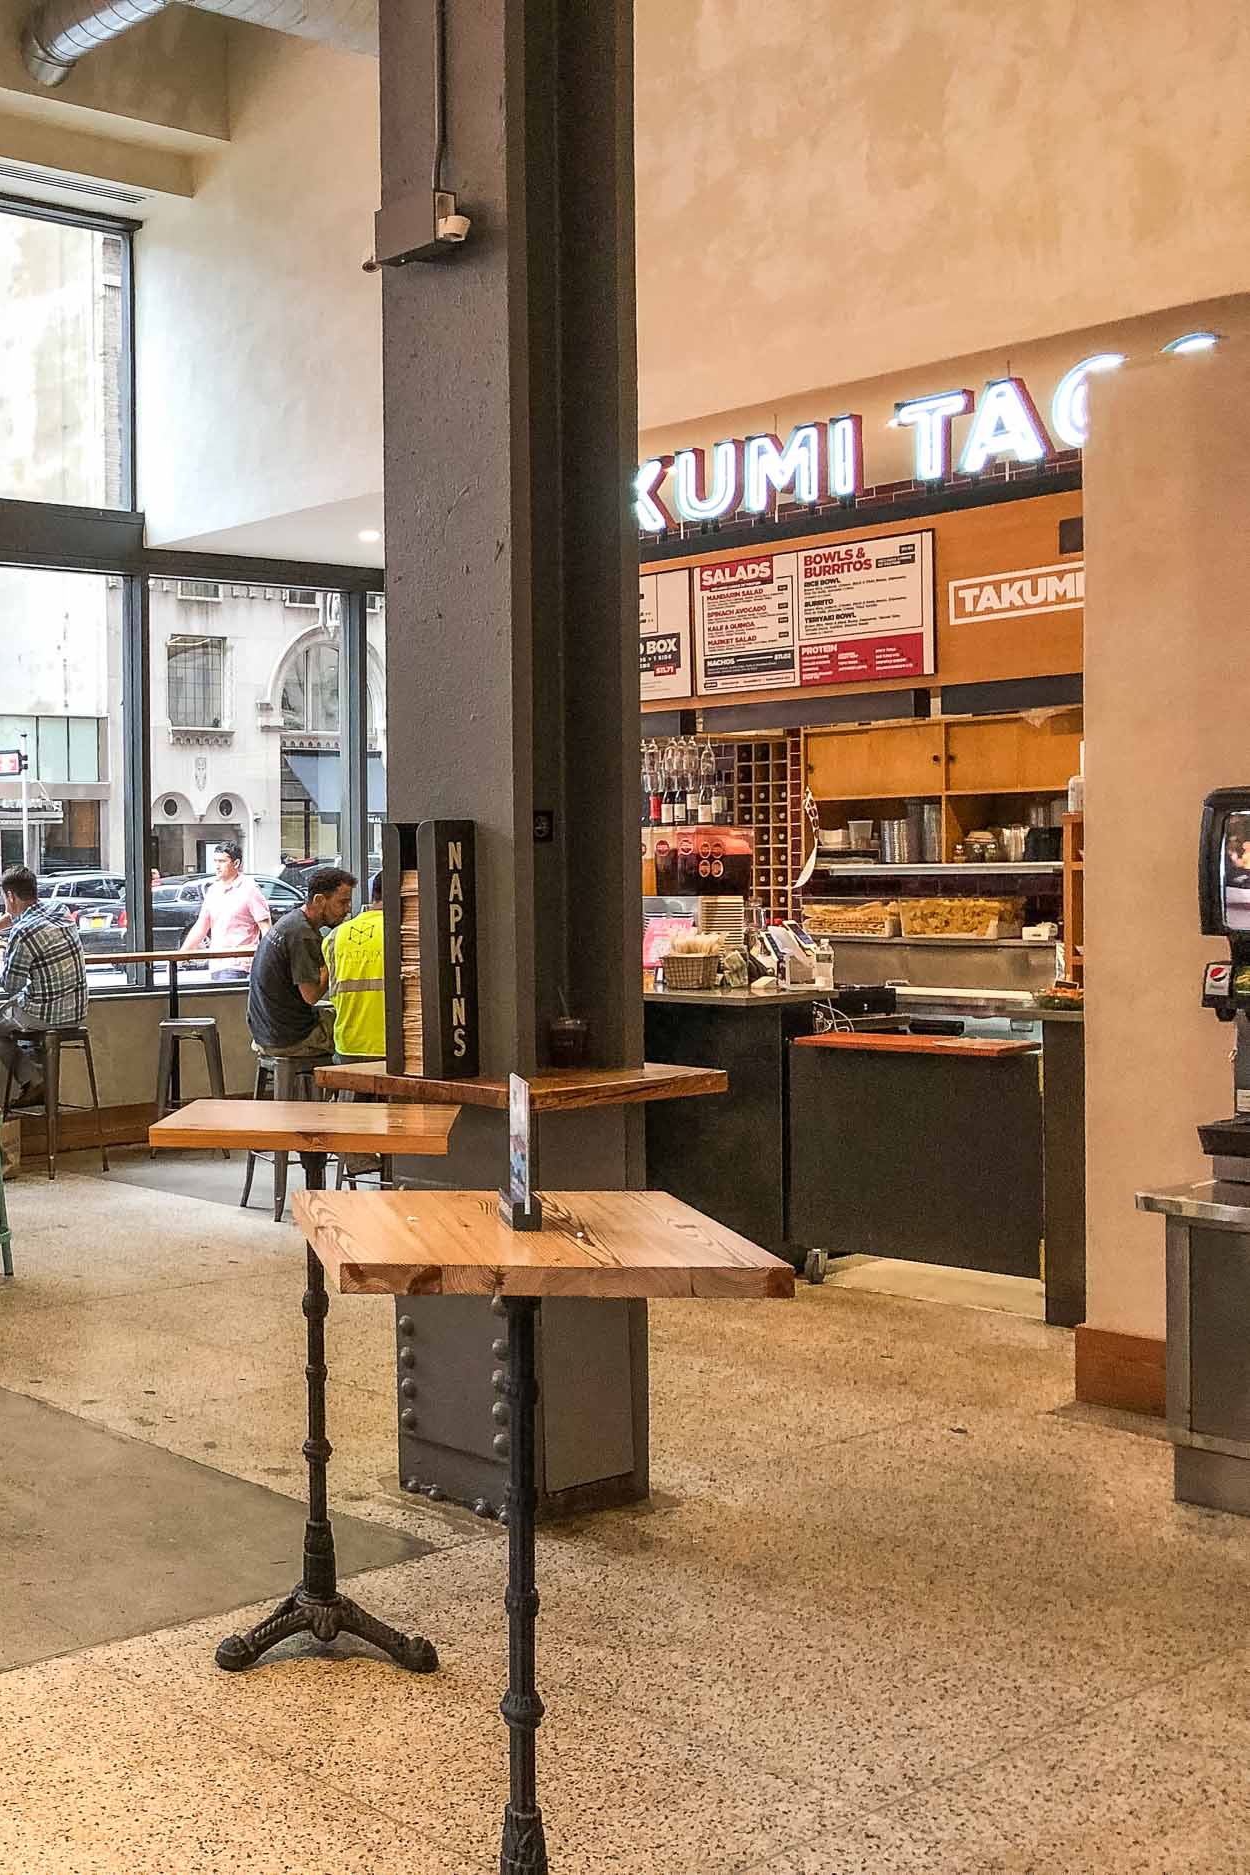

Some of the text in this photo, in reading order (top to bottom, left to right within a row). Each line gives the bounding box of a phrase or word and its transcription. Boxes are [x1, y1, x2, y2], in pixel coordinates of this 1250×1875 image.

[804, 547, 865, 567] BOWLS &
[702, 561, 770, 586] SALADS
[804, 559, 872, 579] BURRITOS
[820, 578, 841, 586] BOWL
[742, 588, 763, 596] SALAD
[958, 571, 1085, 613] TAKUMI
[735, 605, 766, 615] AVOCADO
[836, 612, 856, 621] BOWL
[735, 635, 757, 643] SALAD
[646, 638, 677, 655] BOX
[801, 644, 838, 655] PROTEIN
[707, 658, 735, 667] NACHOS
[448, 842, 466, 1057] NAPKINS
